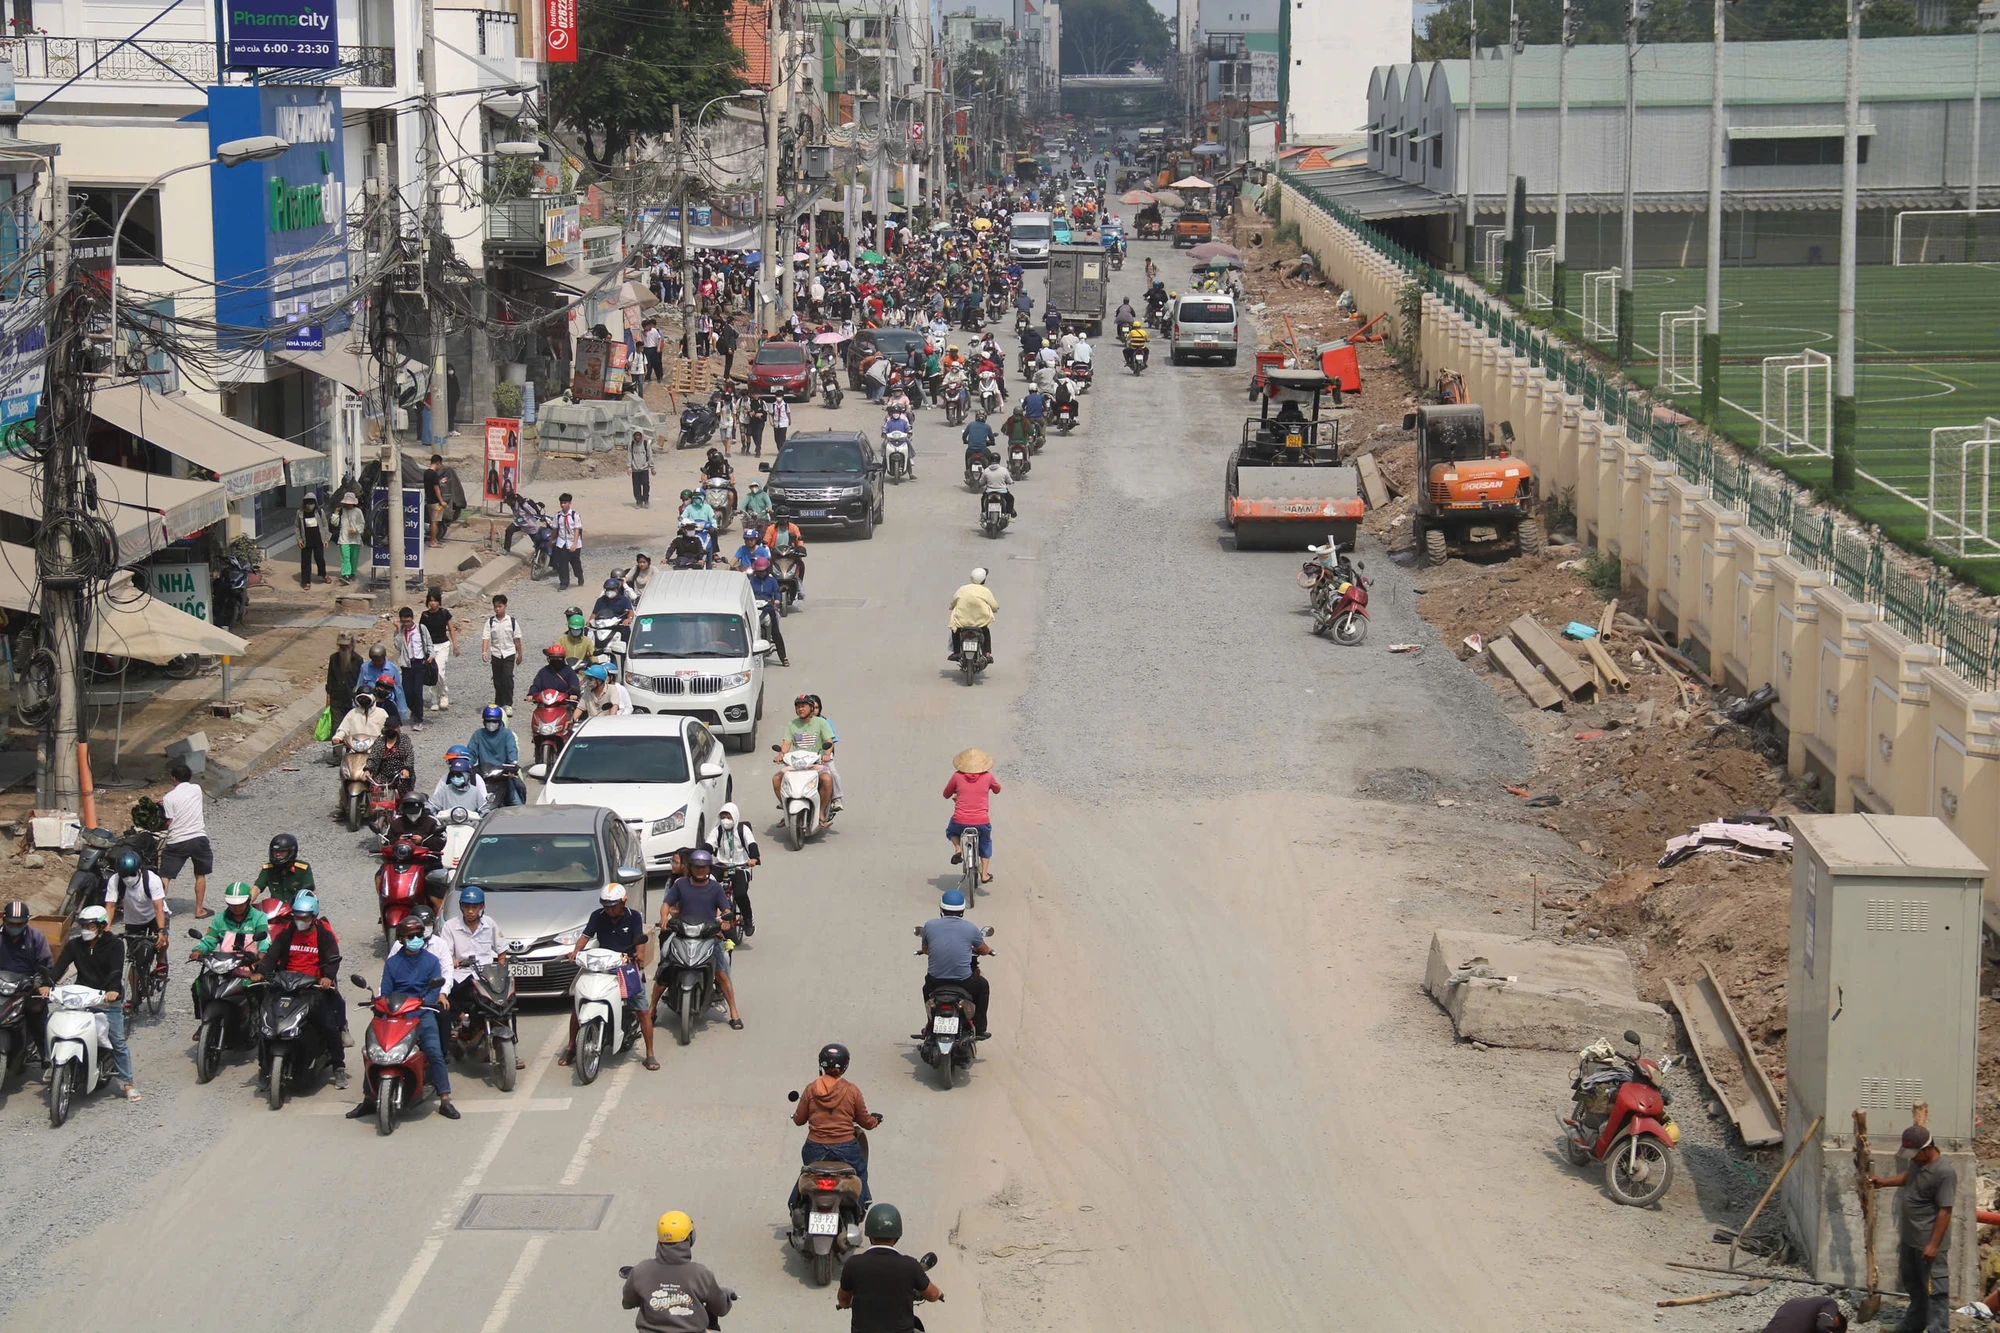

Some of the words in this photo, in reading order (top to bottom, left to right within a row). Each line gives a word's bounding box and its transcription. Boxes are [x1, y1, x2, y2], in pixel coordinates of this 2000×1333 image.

[233, 8, 329, 30] Pharmacity
[263, 44, 288, 53] 6:00
[297, 44, 330, 54] 23:30
[954, 136, 967, 145] GYM
[286, 339, 300, 347] NHÀ
[301, 340, 322, 348] THUỐC
[1461, 481, 1503, 491] DOOSAN
[1284, 504, 1314, 513] HAMM
[158, 568, 195, 593] NHÀ
